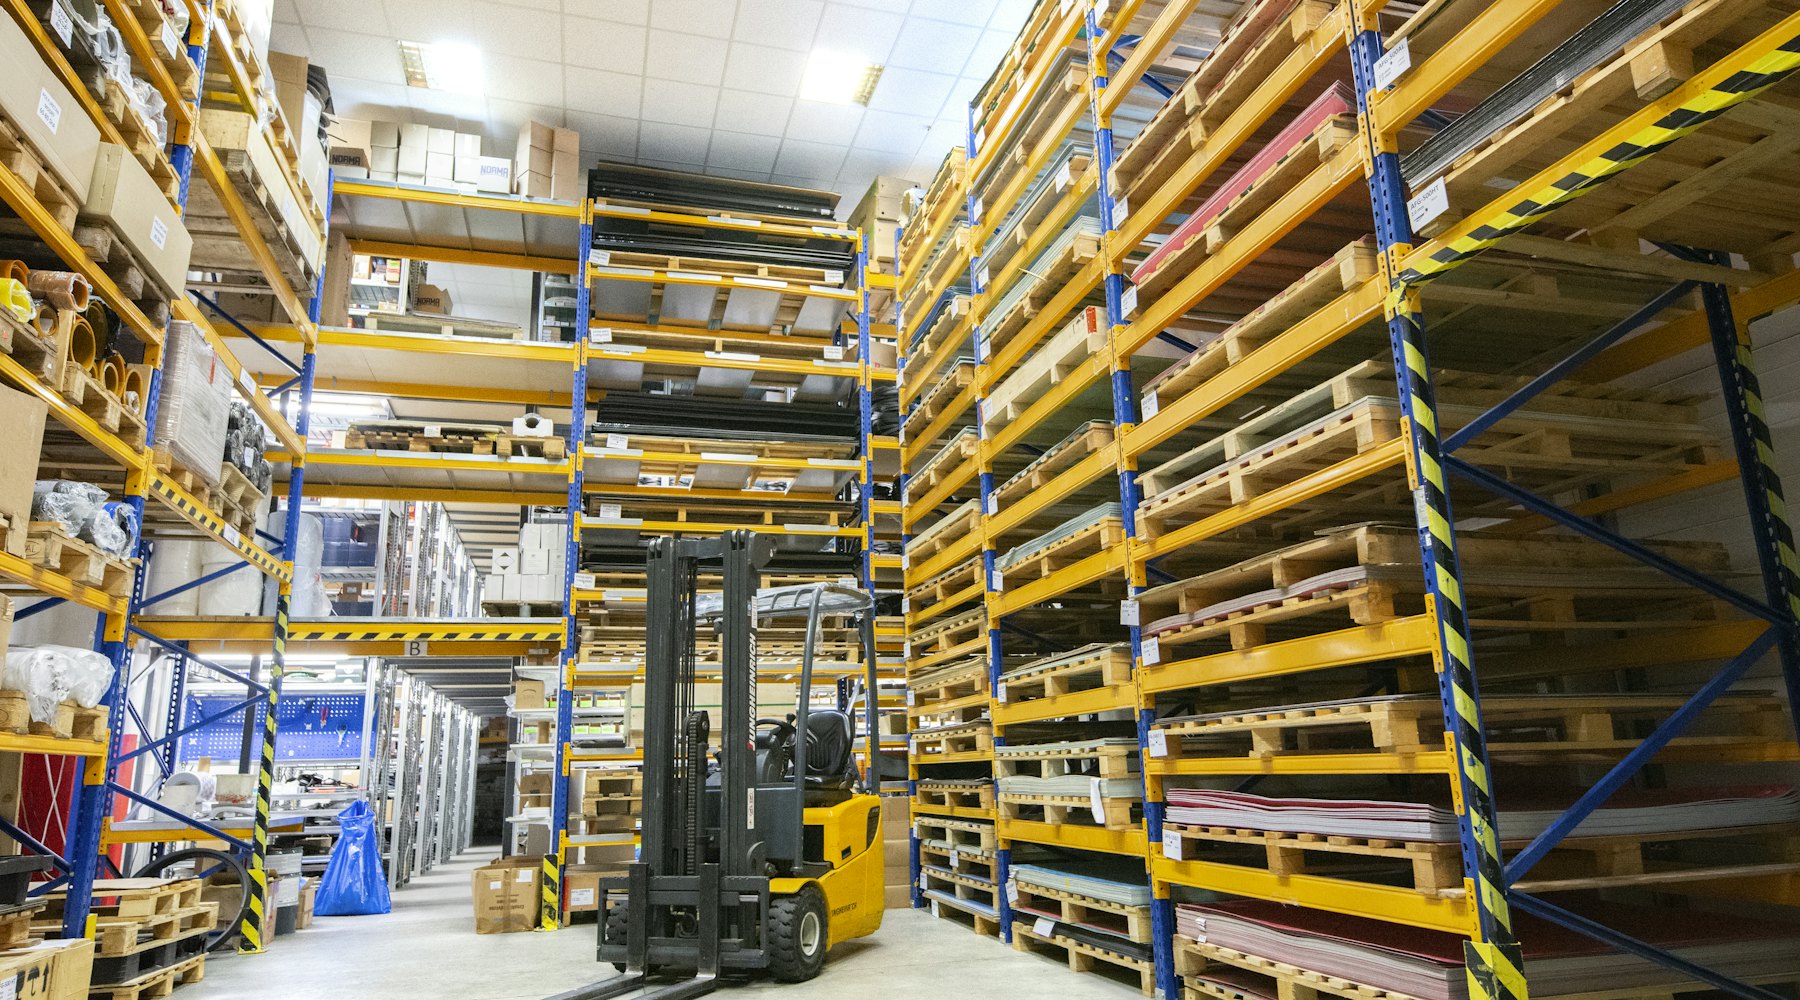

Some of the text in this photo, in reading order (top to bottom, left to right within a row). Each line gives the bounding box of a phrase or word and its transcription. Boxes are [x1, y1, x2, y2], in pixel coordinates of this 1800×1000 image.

[332, 154, 361, 166] NORMA
[480, 164, 509, 178] NORMA
[416, 297, 440, 307] NORMA
[410, 641, 421, 656] B
[746, 632, 756, 752] JUNGHEINRICH
